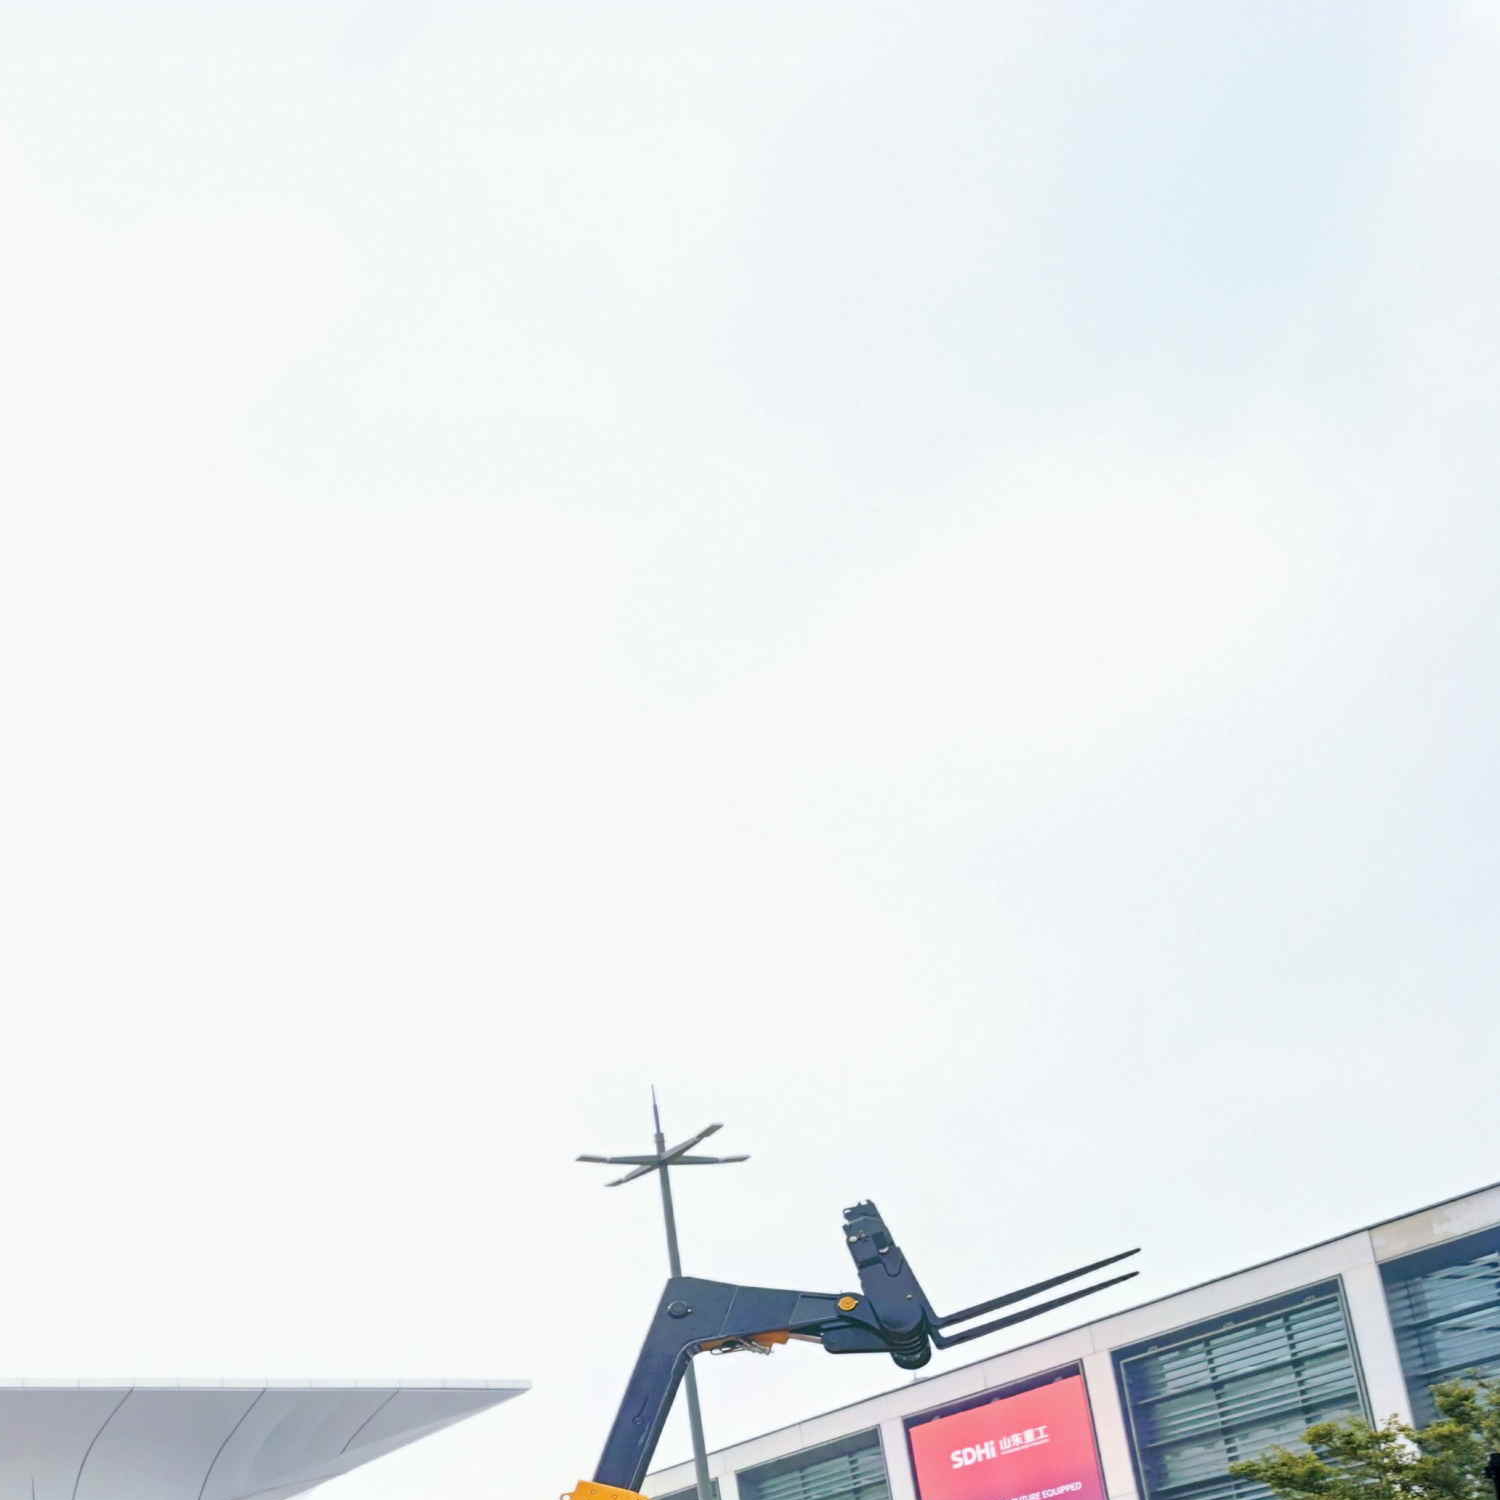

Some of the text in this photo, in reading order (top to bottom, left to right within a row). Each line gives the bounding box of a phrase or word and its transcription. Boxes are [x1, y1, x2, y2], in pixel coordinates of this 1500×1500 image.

[951, 1425, 1049, 1469] SDHi 山东重工
